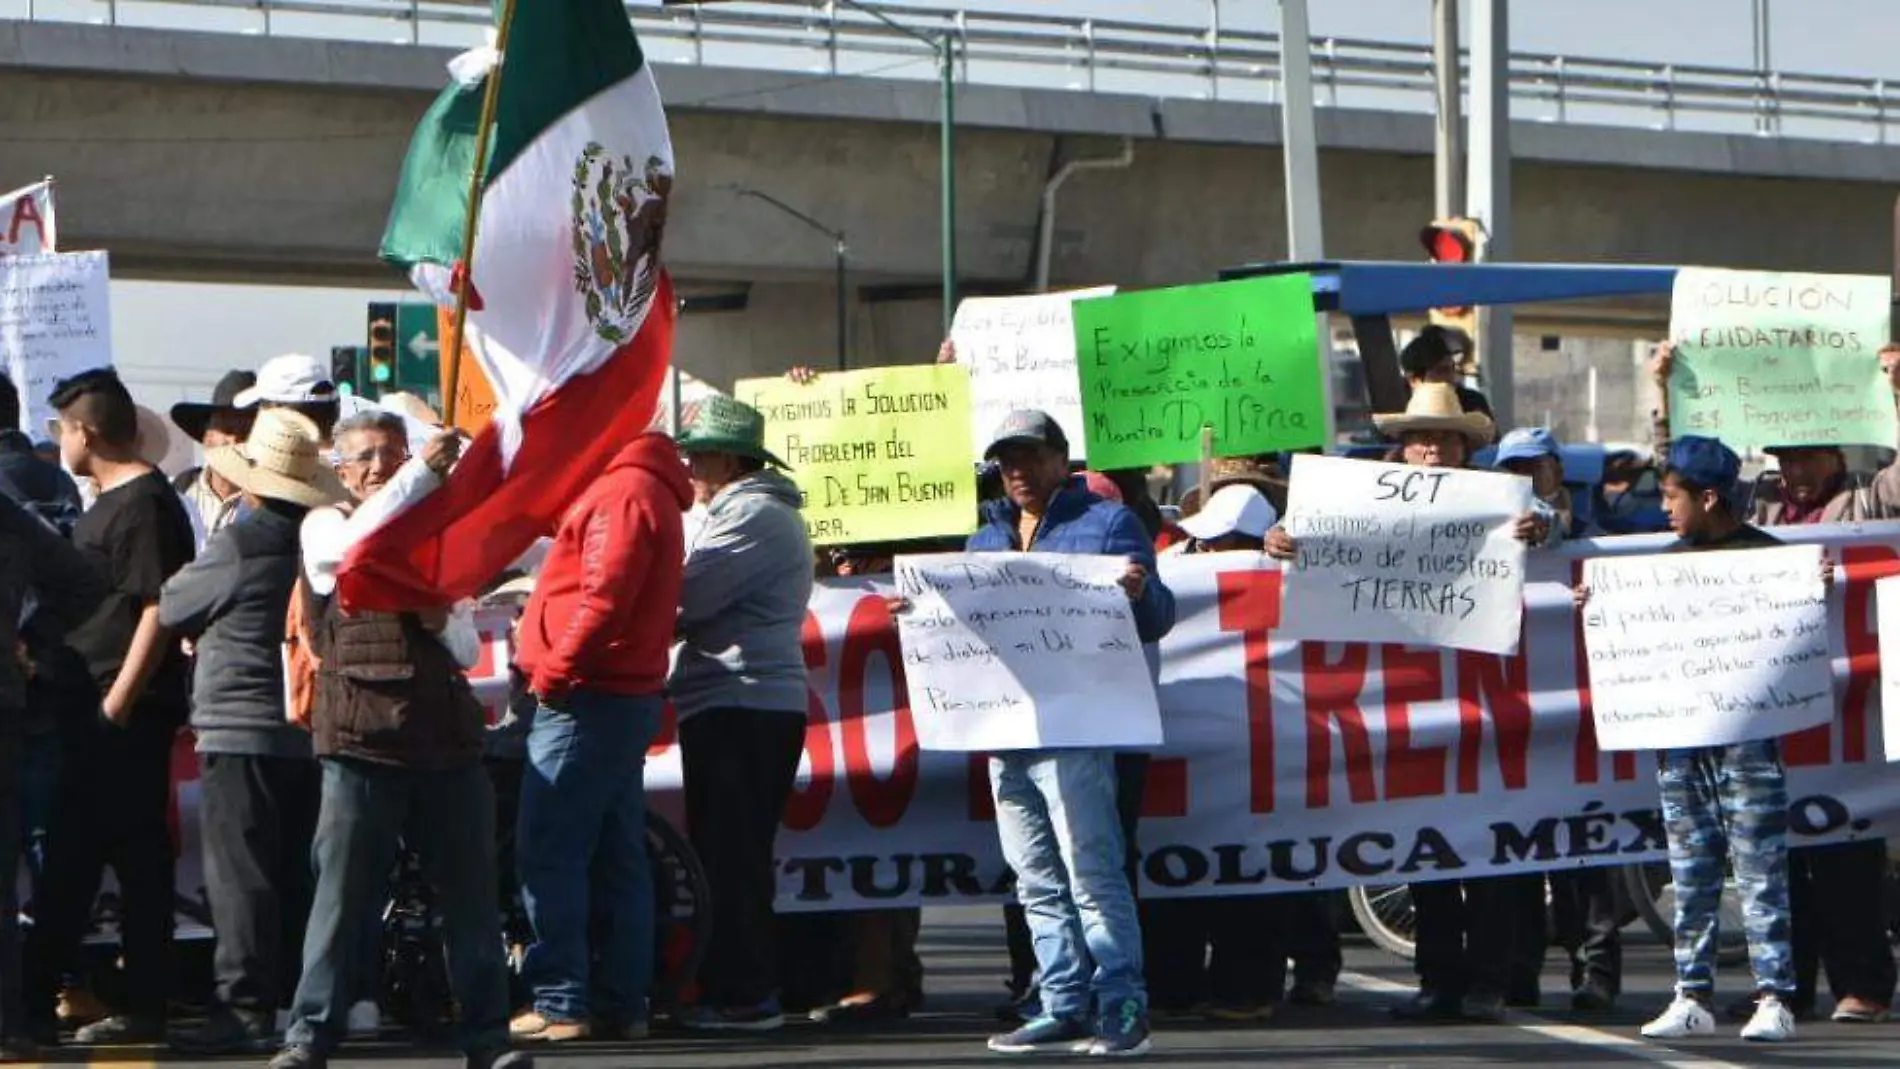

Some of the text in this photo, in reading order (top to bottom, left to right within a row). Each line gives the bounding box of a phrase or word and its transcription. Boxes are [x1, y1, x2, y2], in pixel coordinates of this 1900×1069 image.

[1094, 326, 1231, 375] Exigimos
[1219, 359, 1243, 388] de
[1255, 360, 1274, 384] la
[866, 382, 948, 415] SOLUCION
[787, 434, 876, 464] PROBLEMA
[857, 474, 889, 506] SAN
[896, 472, 954, 502] BUENA
[1375, 470, 1451, 504] SCT
[808, 518, 850, 539] URA.
[1292, 509, 1485, 552] Exigimos el pago
[1376, 544, 1405, 568] de
[1418, 550, 1511, 579] nuestras
[1342, 577, 1475, 620] TIERRAS
[777, 801, 1872, 901] TUR OLUCA MÉXO.
